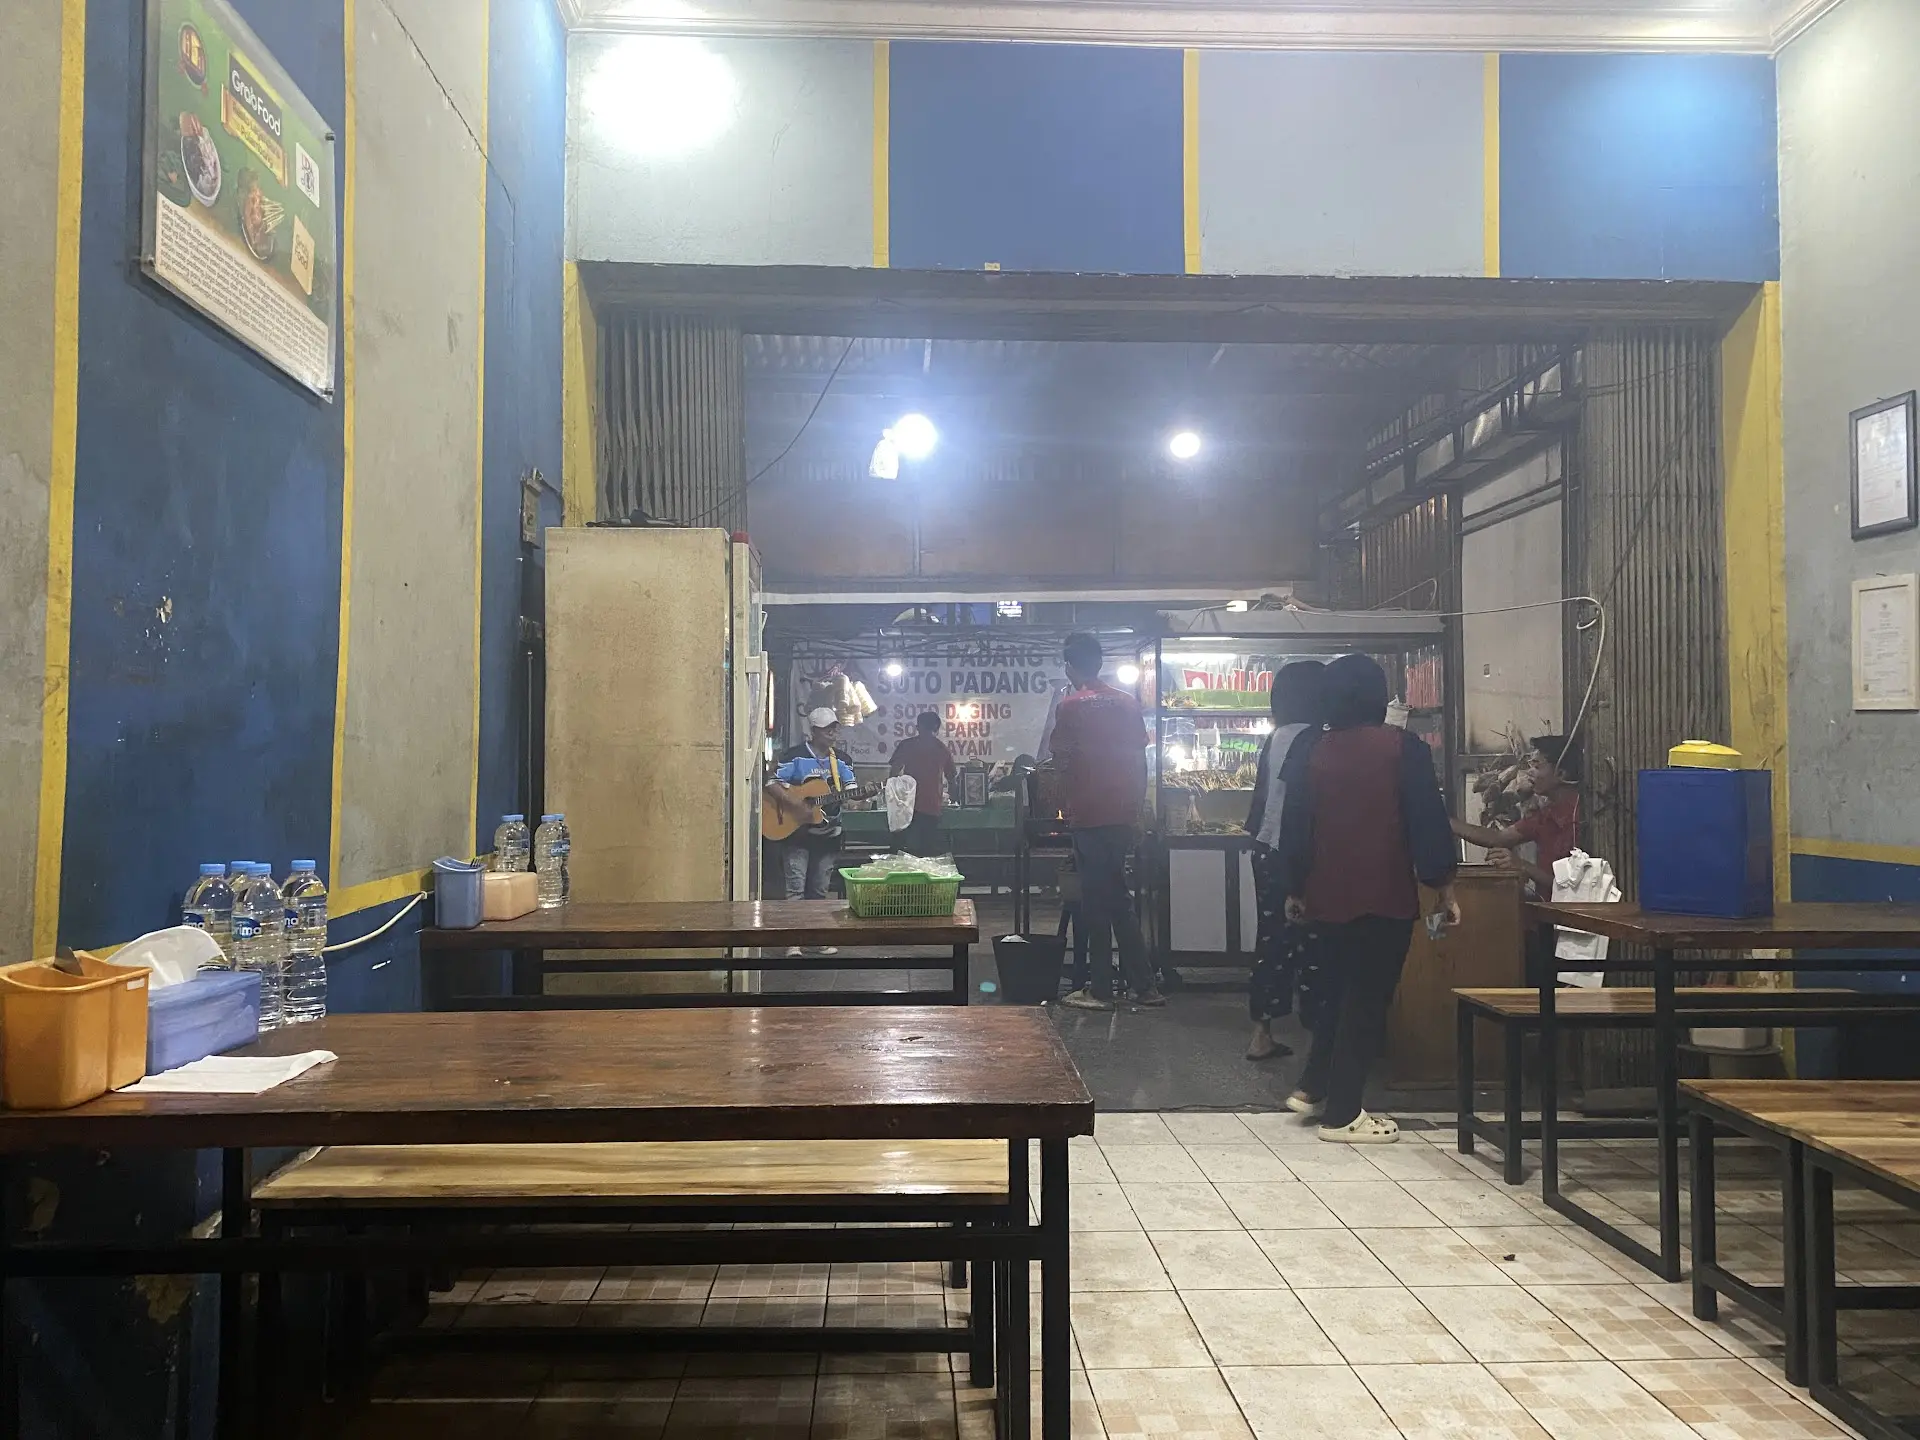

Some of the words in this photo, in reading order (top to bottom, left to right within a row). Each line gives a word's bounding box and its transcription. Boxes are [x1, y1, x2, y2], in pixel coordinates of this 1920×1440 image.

[231, 69, 280, 136] GrabFood
[294, 245, 309, 270] Food
[877, 670, 942, 694] SOTO
[950, 670, 1048, 694] PADANG
[945, 703, 1012, 720] DGING
[945, 721, 992, 738] PARU
[946, 739, 993, 756] AYAM
